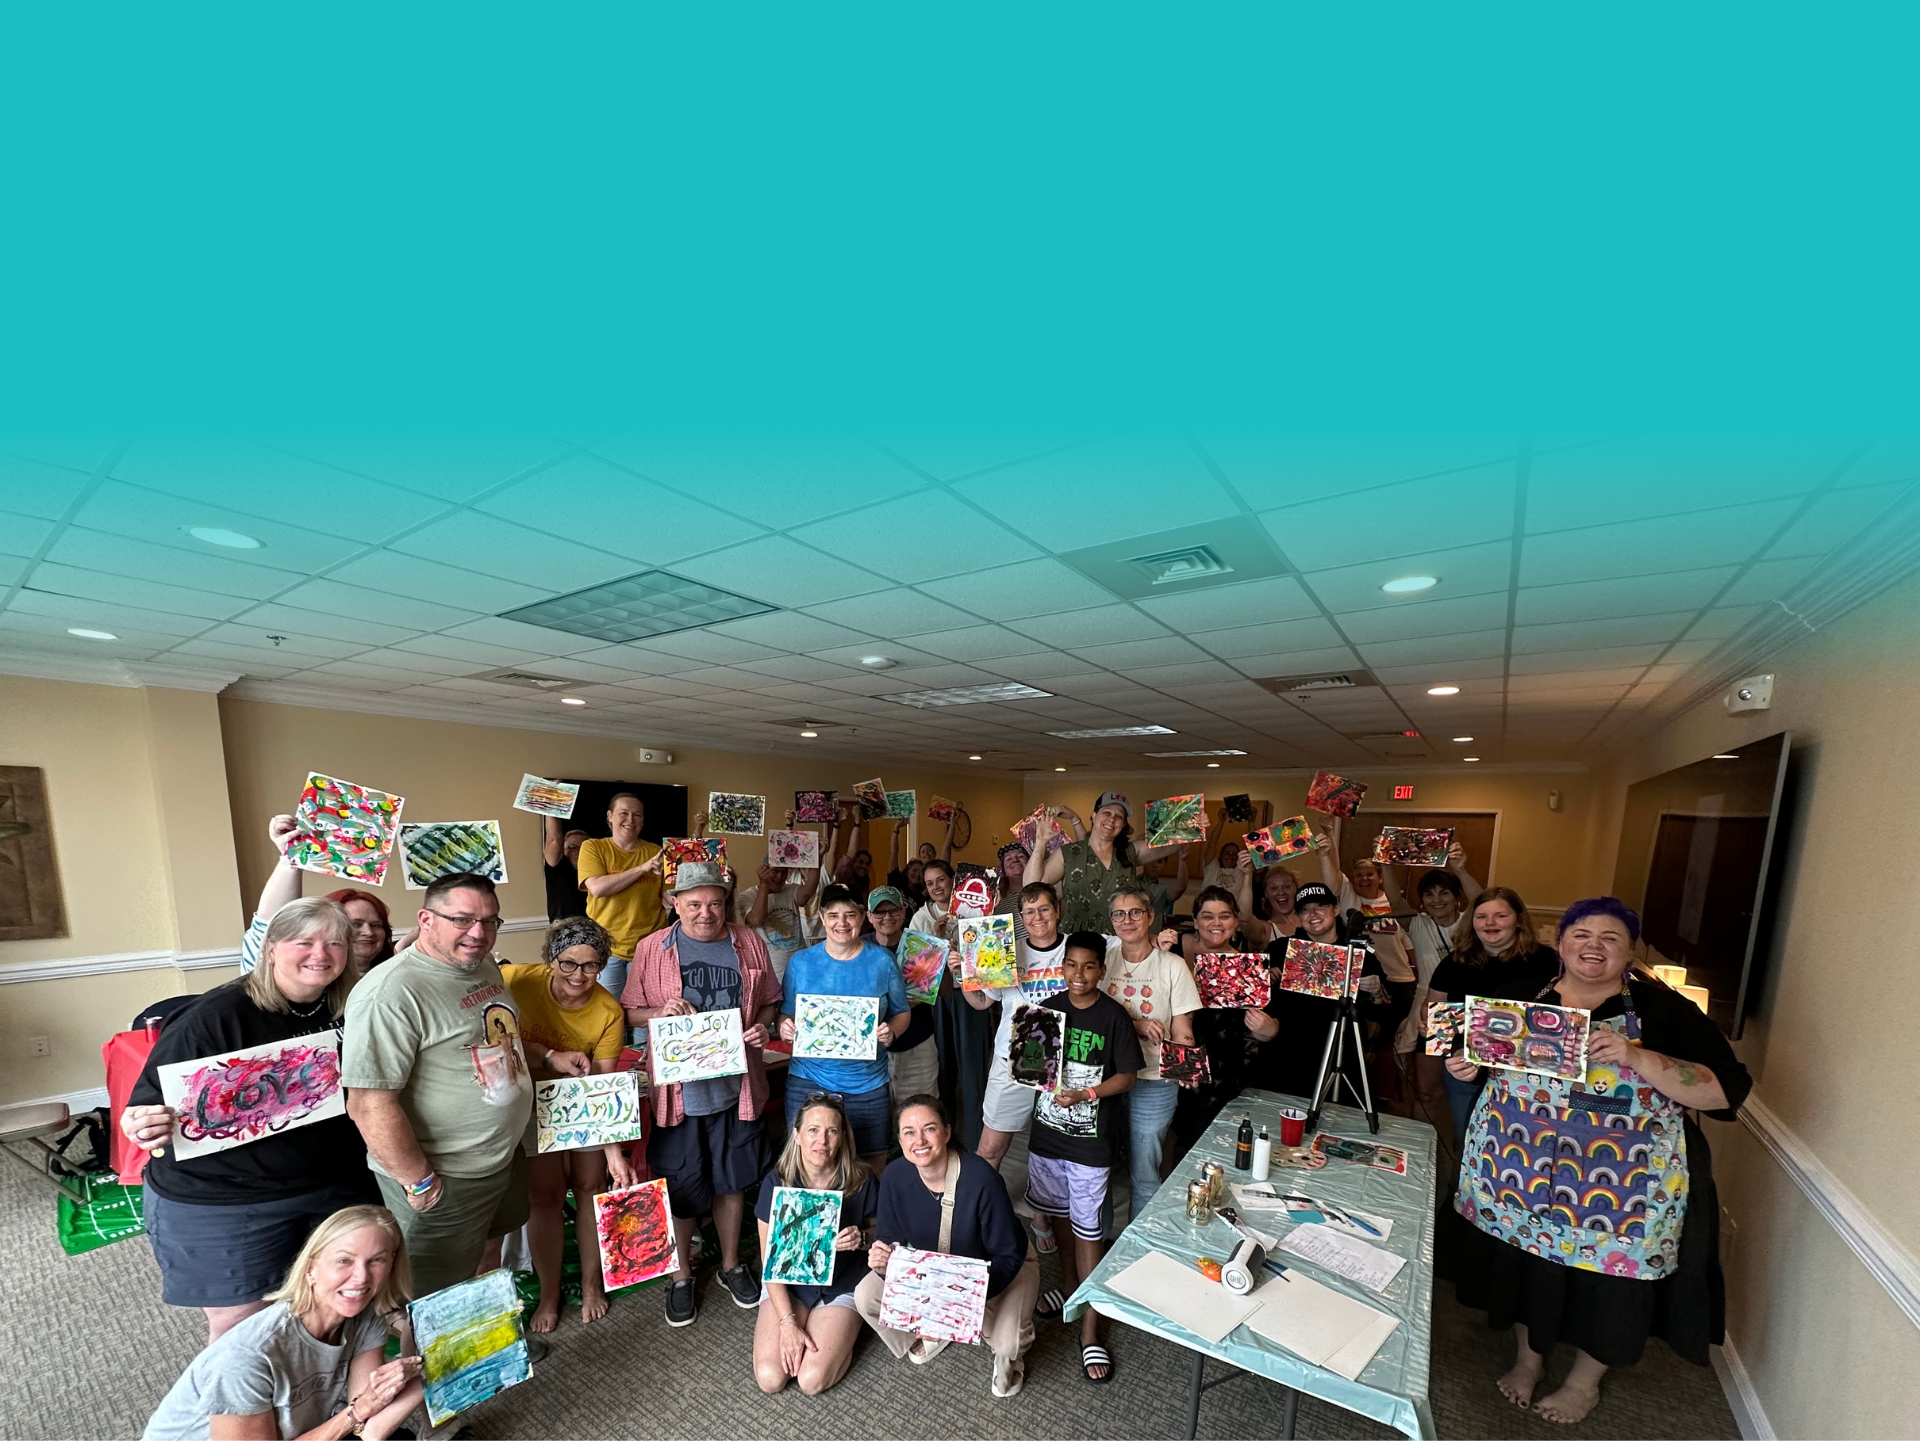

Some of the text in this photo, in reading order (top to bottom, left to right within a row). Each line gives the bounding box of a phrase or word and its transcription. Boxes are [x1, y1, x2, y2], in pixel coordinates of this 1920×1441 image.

[1394, 785, 1414, 799] EXIT
[1296, 886, 1326, 902] DISPATCH
[1003, 937, 1017, 970] HOME
[688, 966, 739, 989] GO WILD
[658, 1014, 731, 1037] FIND JOY
